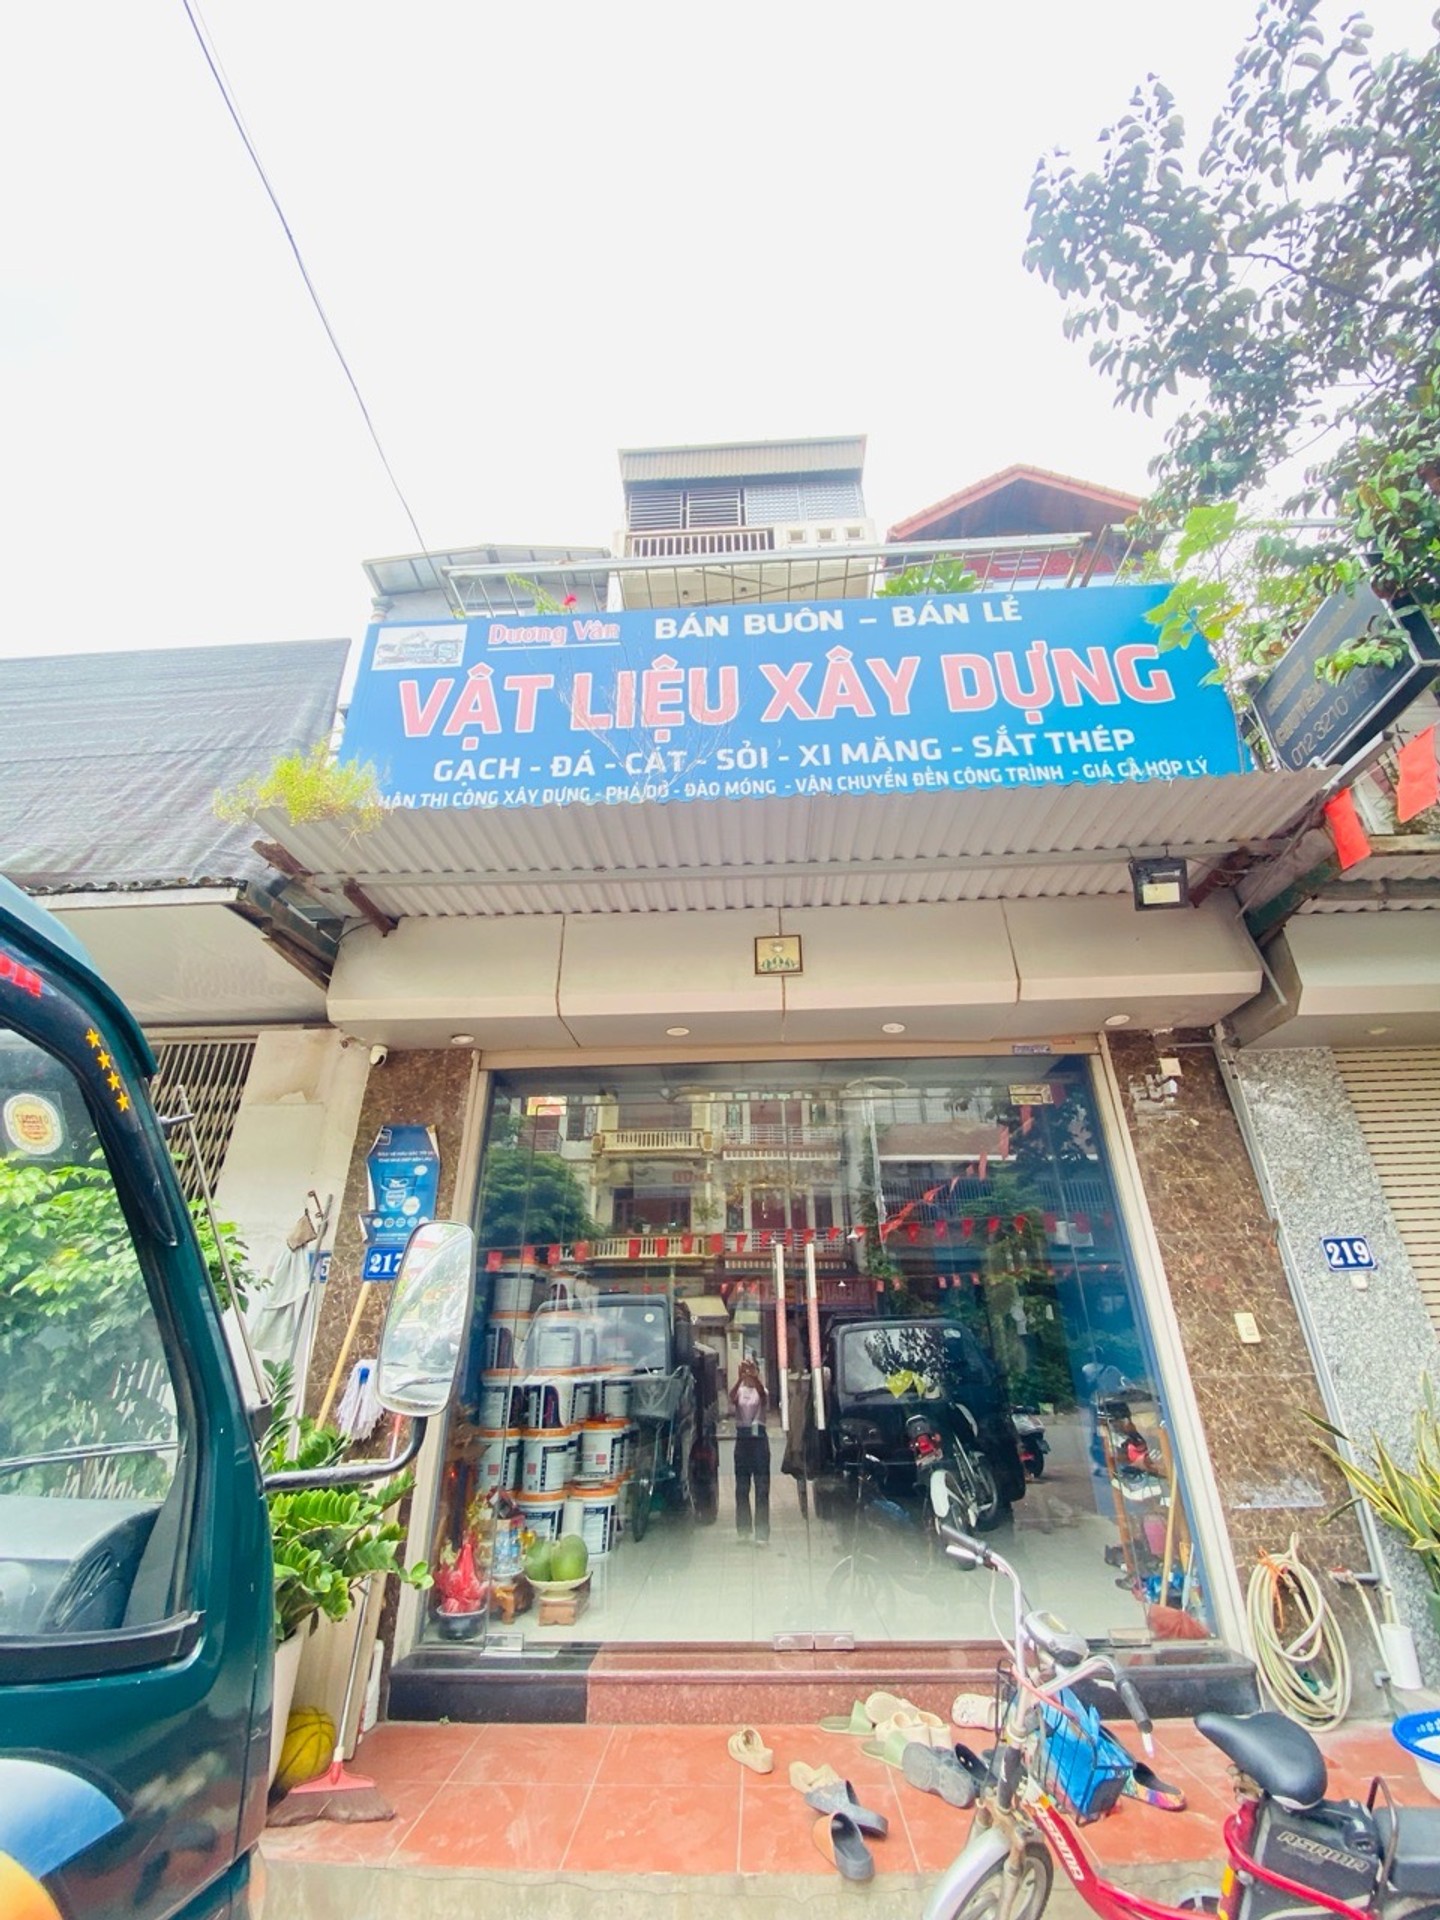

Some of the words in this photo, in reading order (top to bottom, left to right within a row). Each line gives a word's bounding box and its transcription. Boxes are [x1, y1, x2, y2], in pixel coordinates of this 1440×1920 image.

[655, 612, 729, 640] BÁN
[744, 607, 843, 635] BUÔN
[892, 600, 970, 628] BÁN
[983, 594, 1023, 622] LẺ
[399, 661, 554, 752] VẬT
[570, 653, 740, 744] LIỆU
[758, 645, 921, 722] XÂY
[940, 640, 1176, 726] DỰNG
[433, 757, 521, 788] GẠCH
[550, 748, 595, 777] ĐÁ
[625, 746, 688, 777] CÁT
[716, 740, 768, 771] SỎI
[799, 744, 831, 767] XI
[842, 736, 942, 766] MĂNG
[972, 724, 1036, 759] SẮT
[1044, 724, 1136, 755] THÉP
[420, 792, 449, 808] THI
[452, 788, 498, 807] CÔNG
[503, 785, 539, 805] XÂY
[684, 779, 720, 798] ĐÀO
[725, 775, 776, 796] MÓNG
[794, 773, 833, 796] VẬN
[836, 766, 908, 789] CHUYỂN
[953, 766, 1000, 785] CÔNG
[1005, 763, 1064, 782] TRÌNH
[1082, 759, 1115, 779] GIÁ
[1144, 758, 1183, 780] HỢP
[1186, 755, 1208, 775] LÝ
[369, 1252, 403, 1273] 217
[1326, 1241, 1370, 1265] 219
[1277, 1831, 1369, 1874] ASAMA
